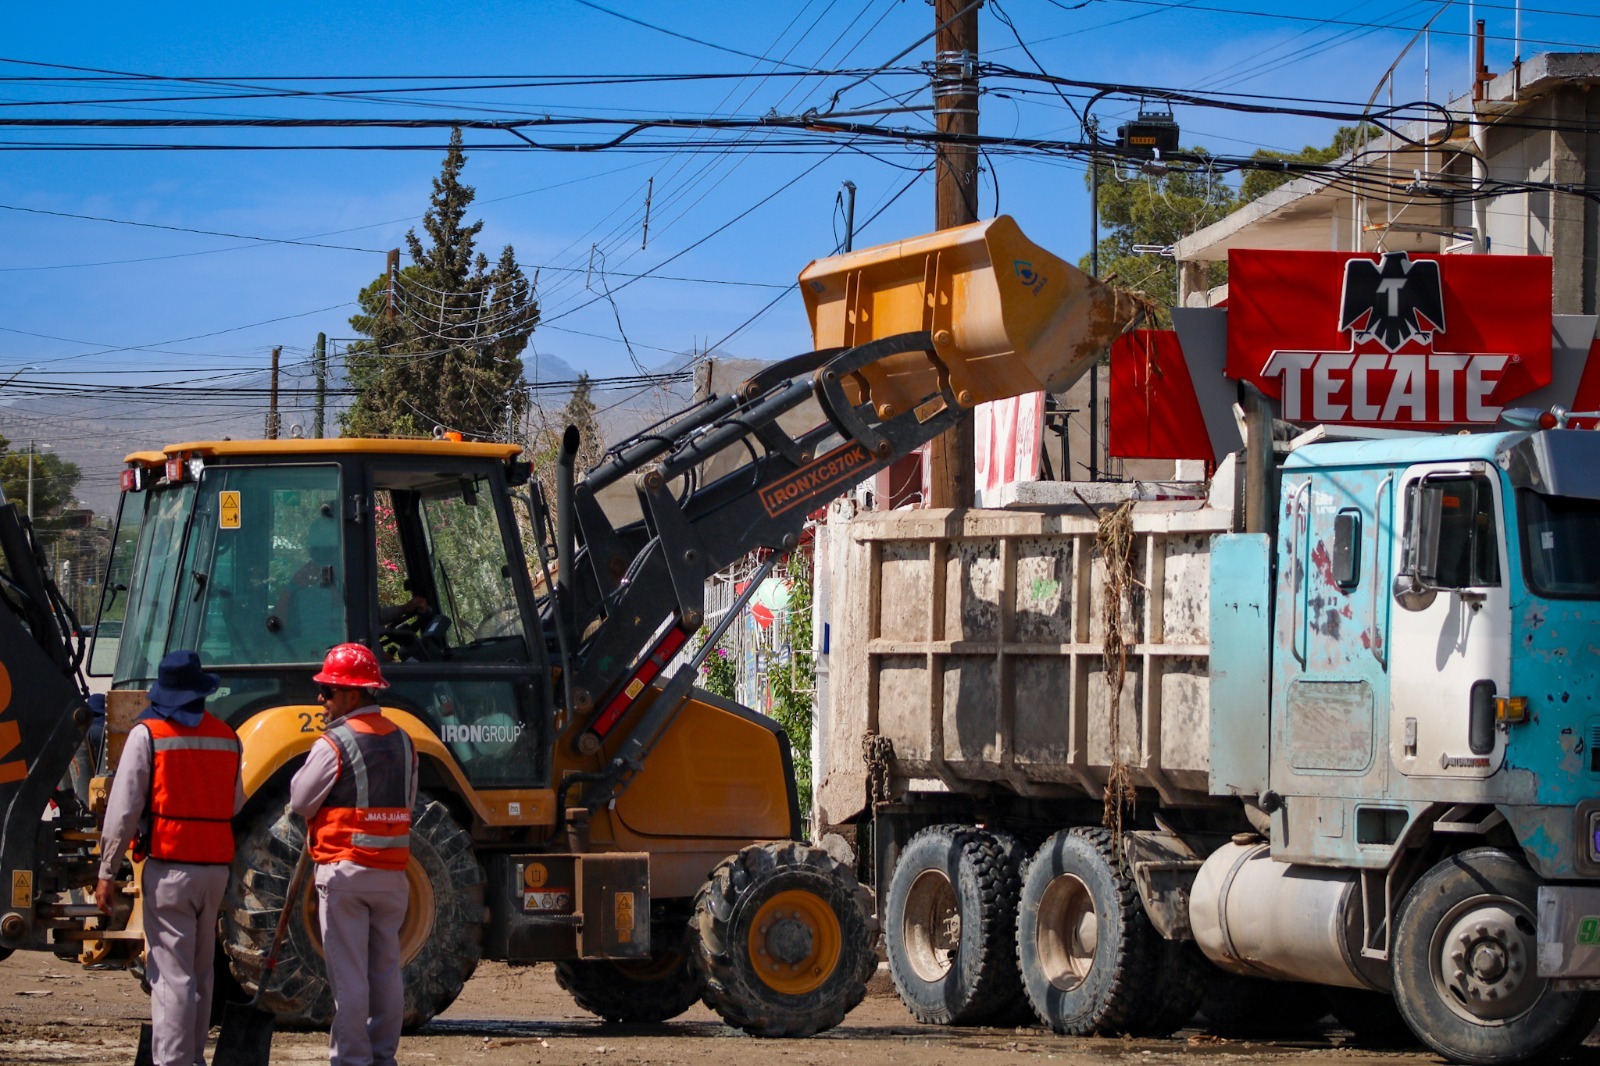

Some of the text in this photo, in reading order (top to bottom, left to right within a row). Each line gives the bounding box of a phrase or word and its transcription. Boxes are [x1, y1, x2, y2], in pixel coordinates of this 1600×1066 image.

[1376, 277, 1408, 318] T
[1263, 353, 1513, 423] TECATE
[364, 812, 387, 822] JMAS
